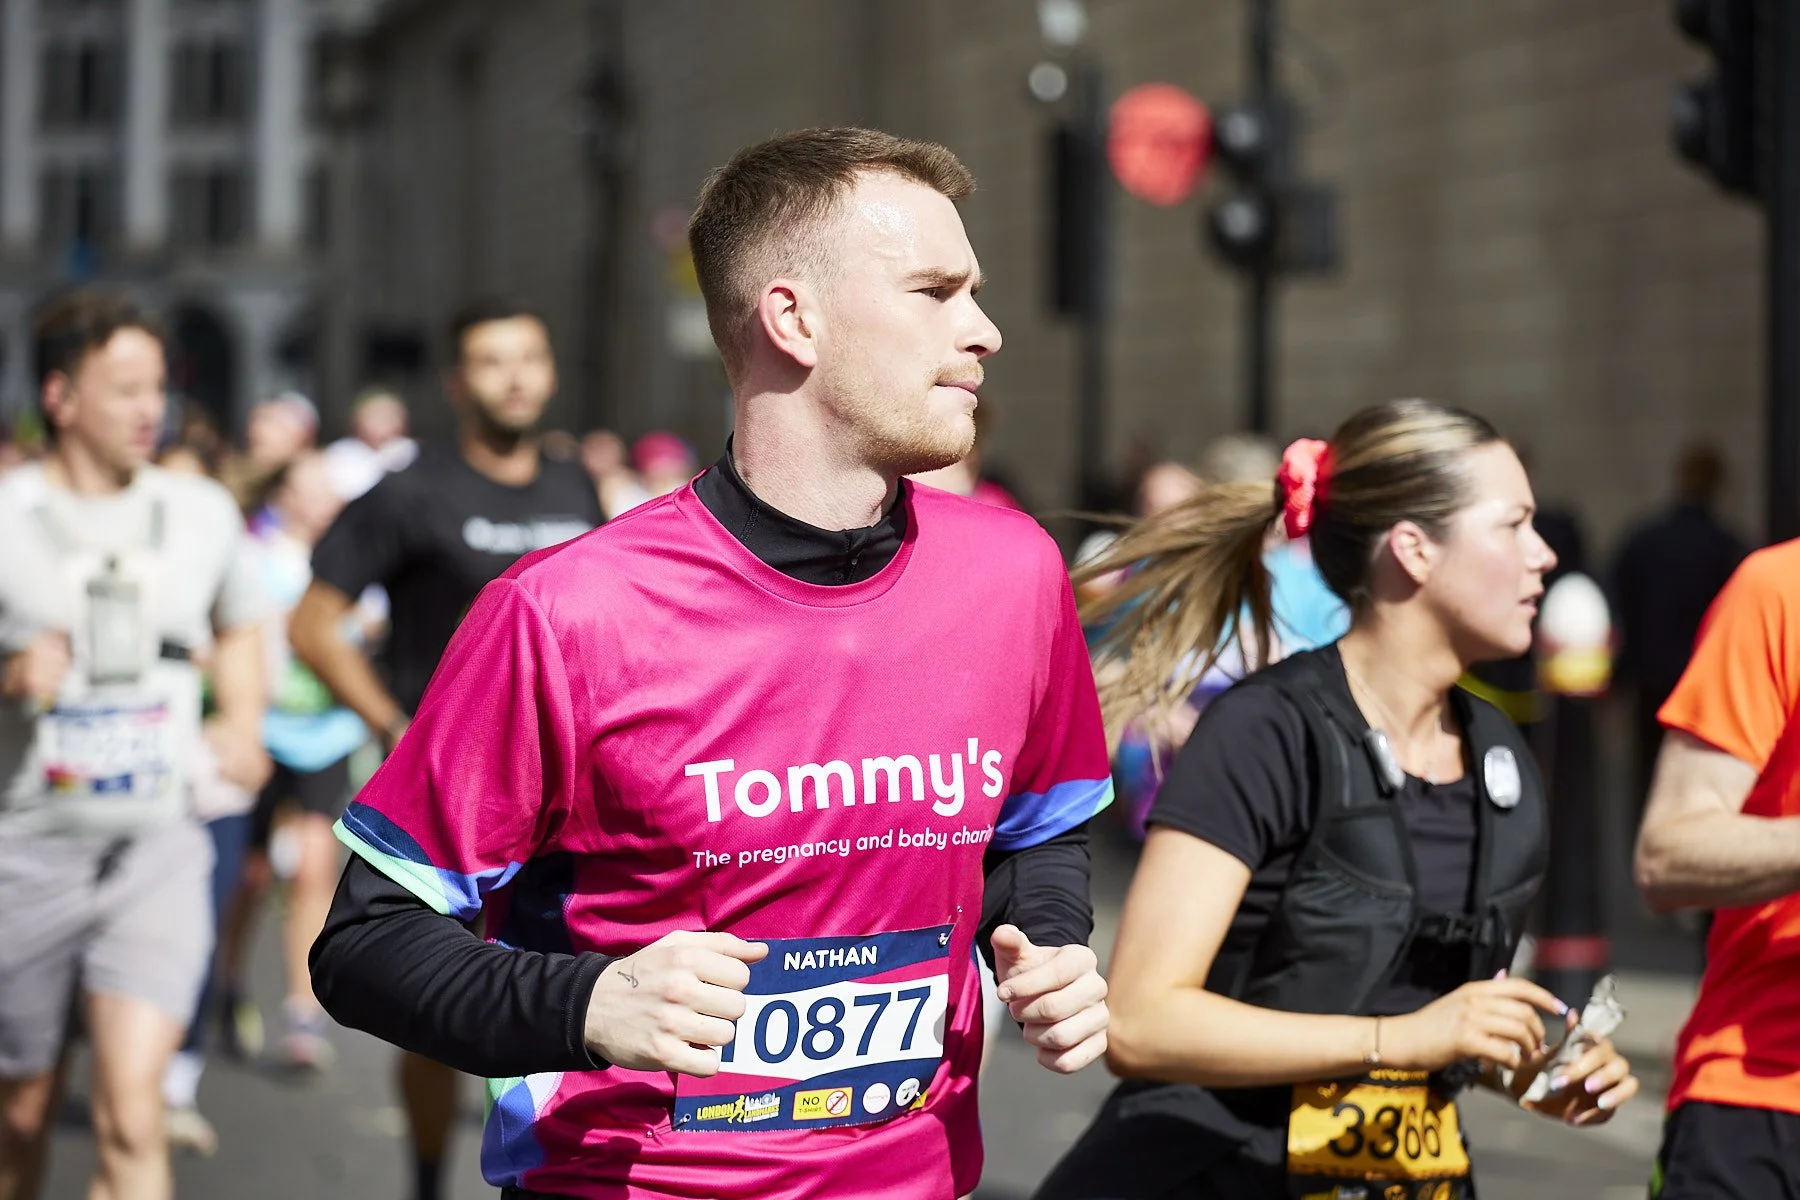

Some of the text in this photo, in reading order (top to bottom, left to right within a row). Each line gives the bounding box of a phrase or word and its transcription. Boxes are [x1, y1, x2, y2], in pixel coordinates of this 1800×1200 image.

[685, 738, 1004, 822] Tommy's
[693, 851, 731, 868] The
[738, 837, 850, 867] pregnancy
[856, 829, 893, 851] and
[898, 826, 947, 850] baby
[783, 946, 878, 971] NATHAN
[696, 1103, 735, 1120] LONDON
[802, 1096, 820, 1106] NO
[1328, 1103, 1442, 1160] 3366
